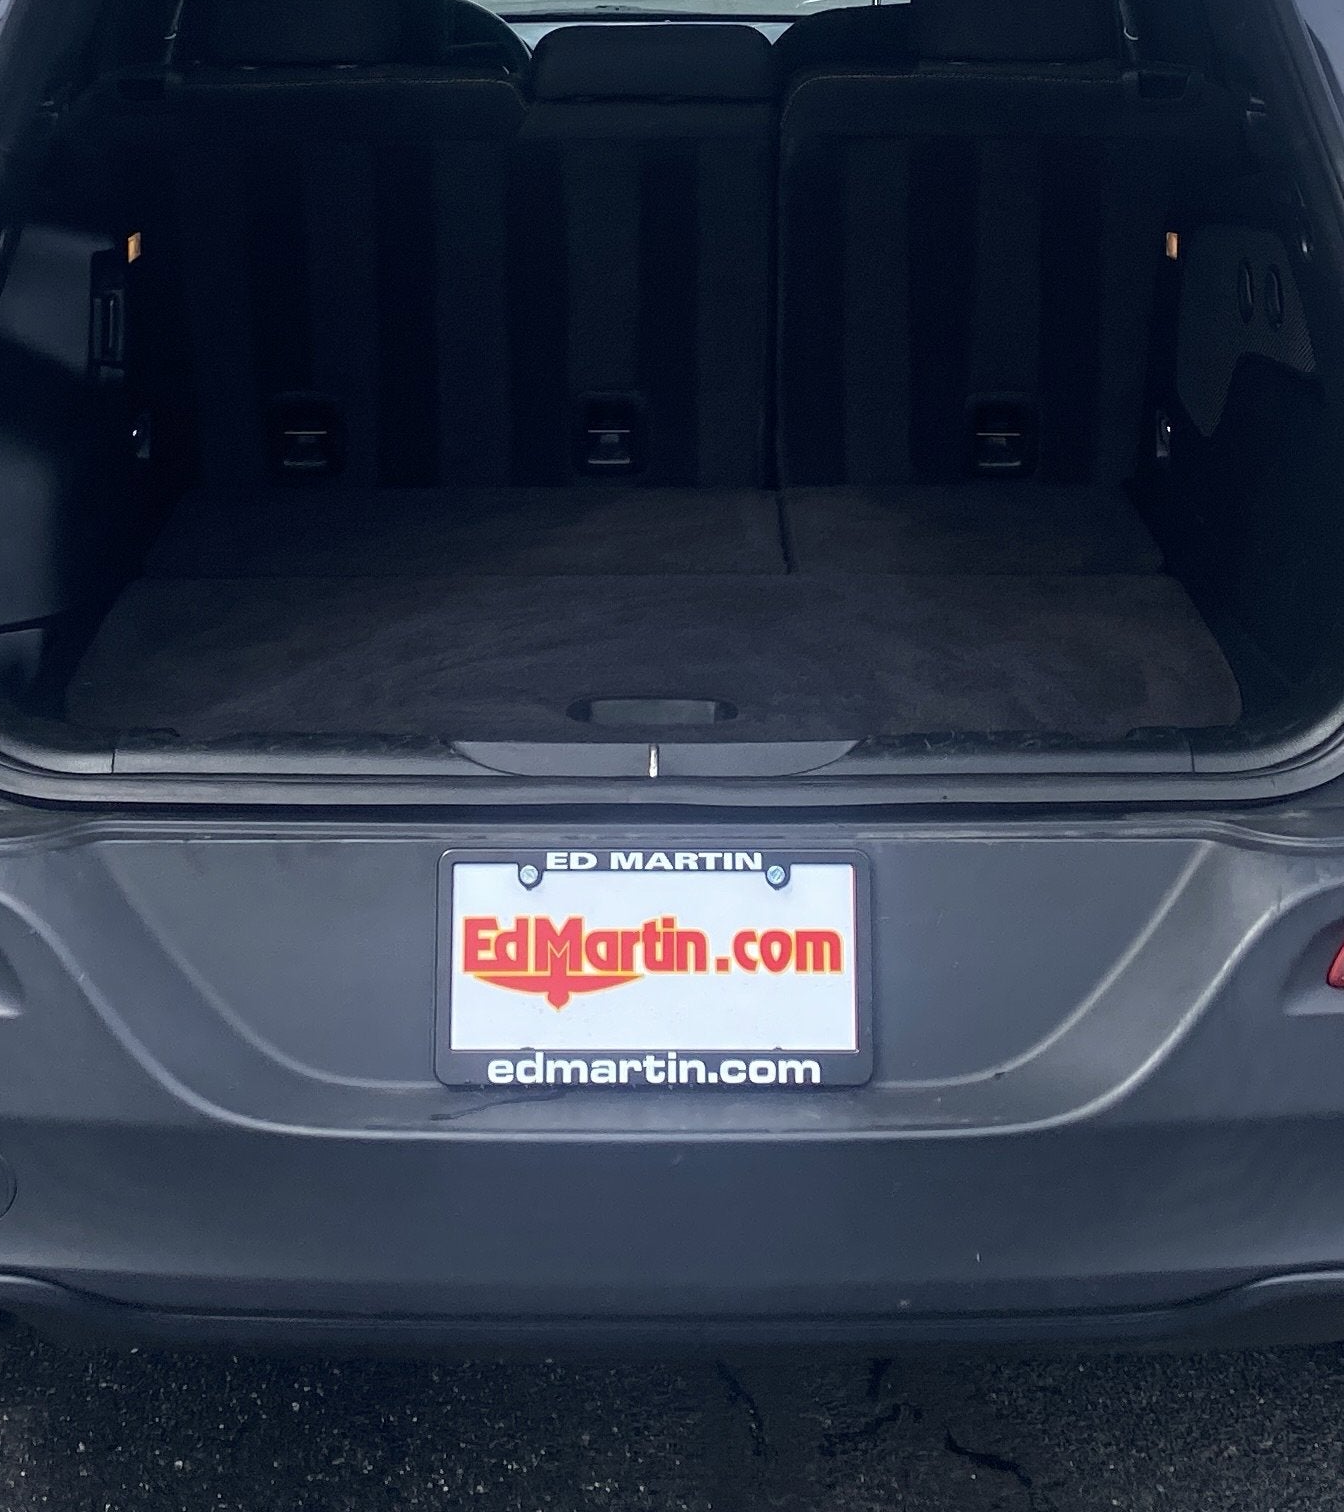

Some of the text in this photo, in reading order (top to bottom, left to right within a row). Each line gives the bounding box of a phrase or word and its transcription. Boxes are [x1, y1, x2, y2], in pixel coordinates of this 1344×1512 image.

[546, 851, 763, 871] ED MARTIN
[462, 915, 843, 978] EdMartin.com
[487, 1052, 821, 1085] edmartin.com
